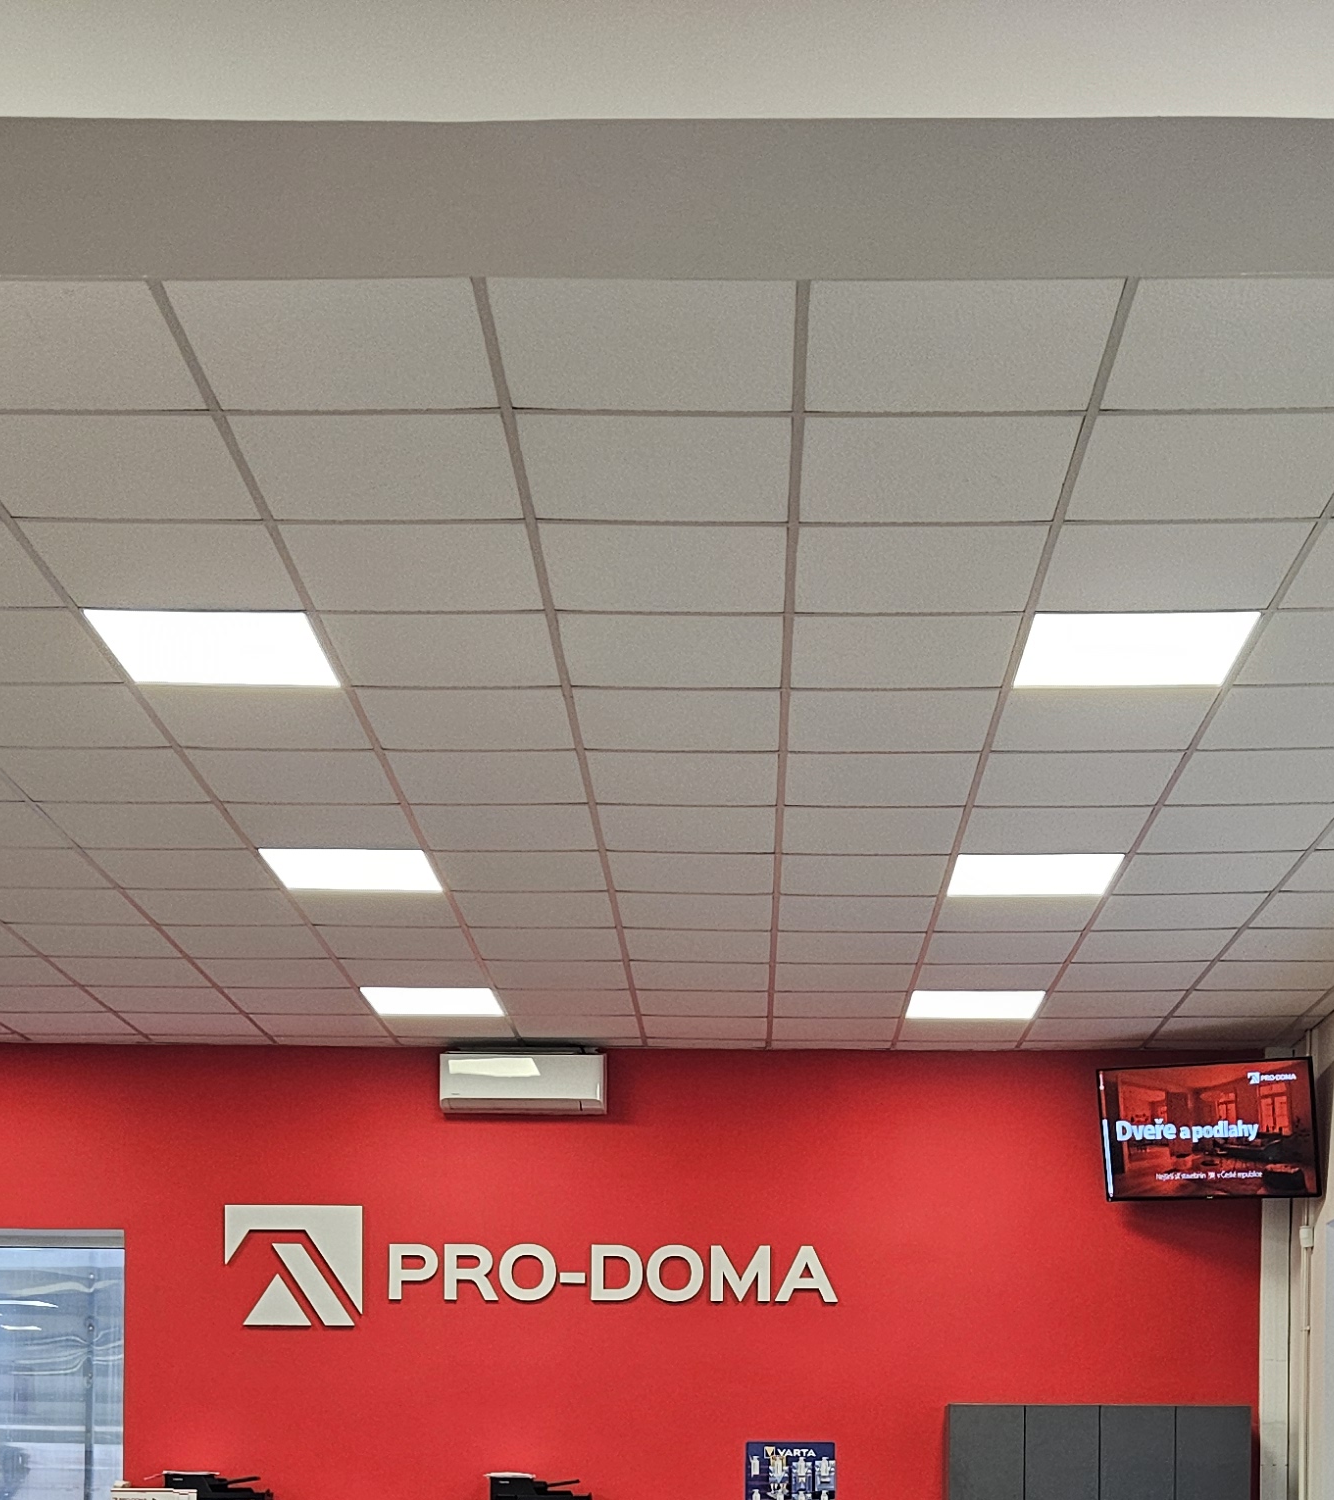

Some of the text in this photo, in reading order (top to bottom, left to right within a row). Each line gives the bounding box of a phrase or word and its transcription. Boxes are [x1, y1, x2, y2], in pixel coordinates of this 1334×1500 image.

[1116, 1118, 1260, 1143] Dveře a podlahy
[387, 1242, 839, 1304] PRO-DOMA
[777, 1448, 817, 1458] VARTA
